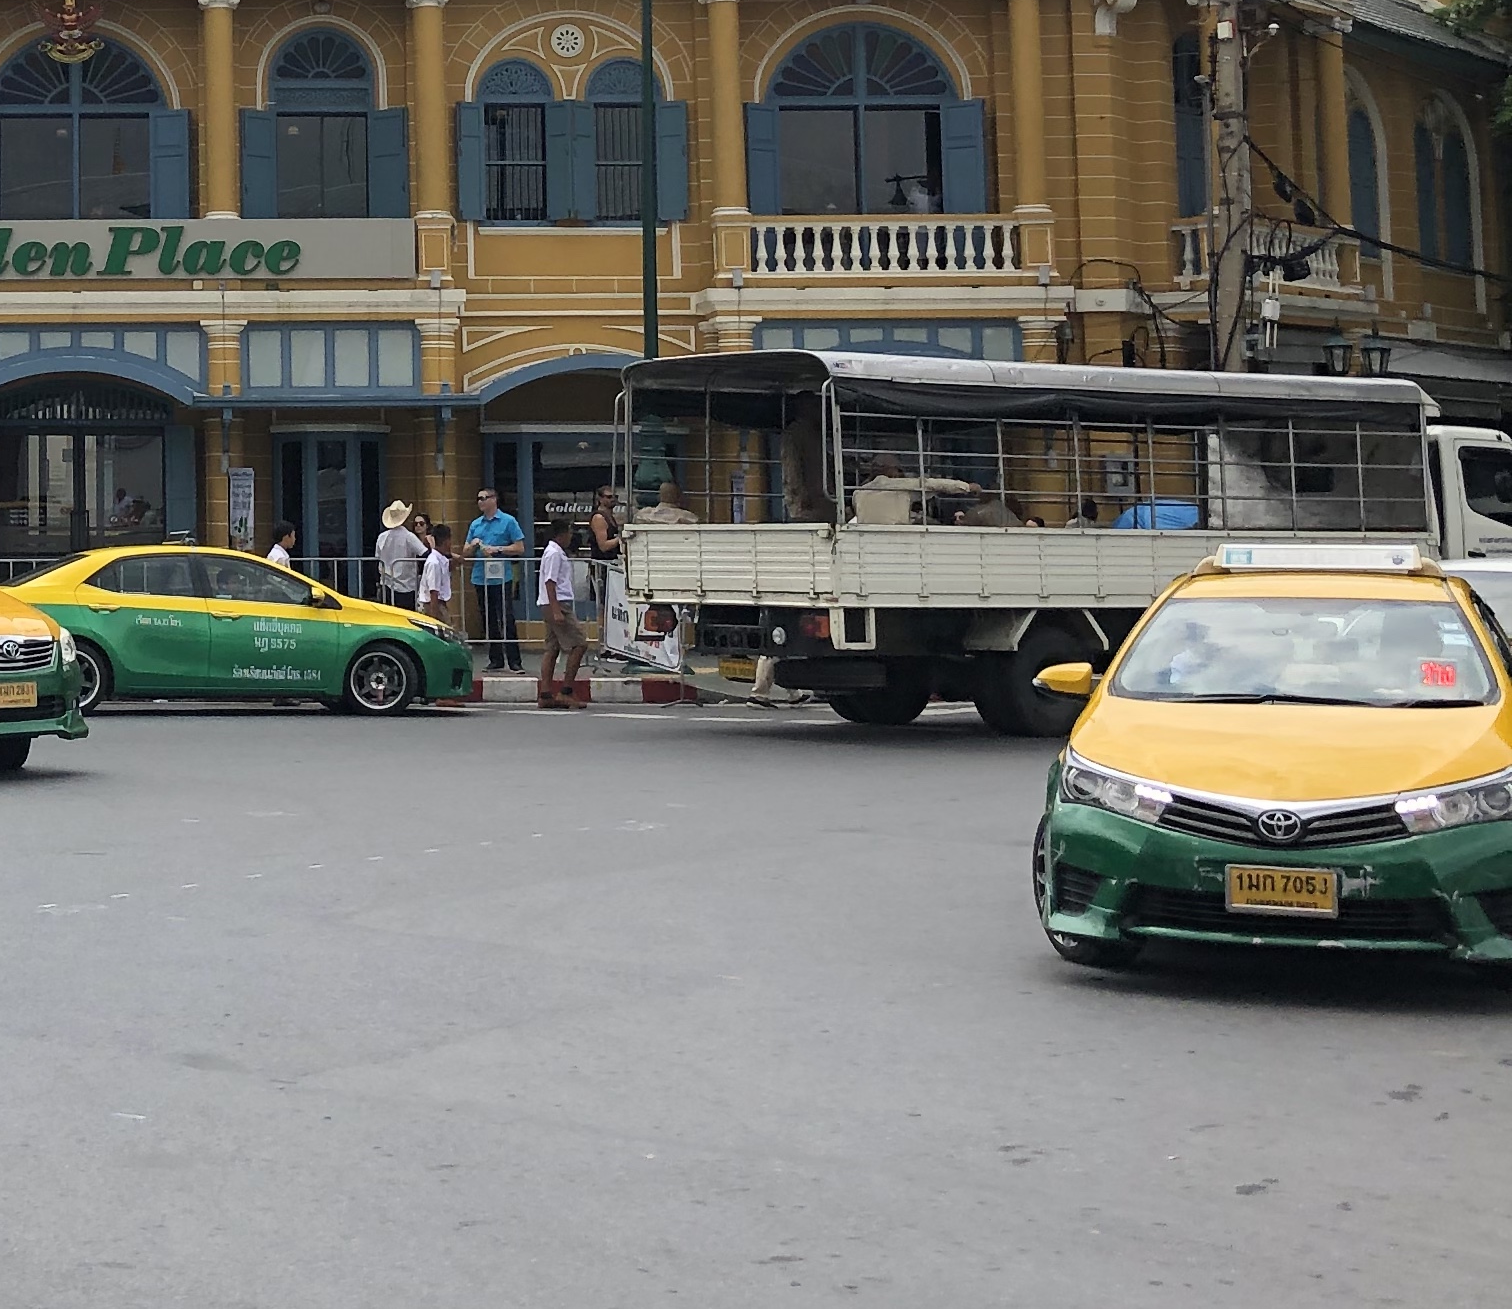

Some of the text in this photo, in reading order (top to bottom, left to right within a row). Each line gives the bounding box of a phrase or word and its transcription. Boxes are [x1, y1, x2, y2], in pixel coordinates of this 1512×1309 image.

[96, 226, 301, 276] Place
[545, 502, 593, 513] Golden
[1236, 872, 1275, 892] 1มก
